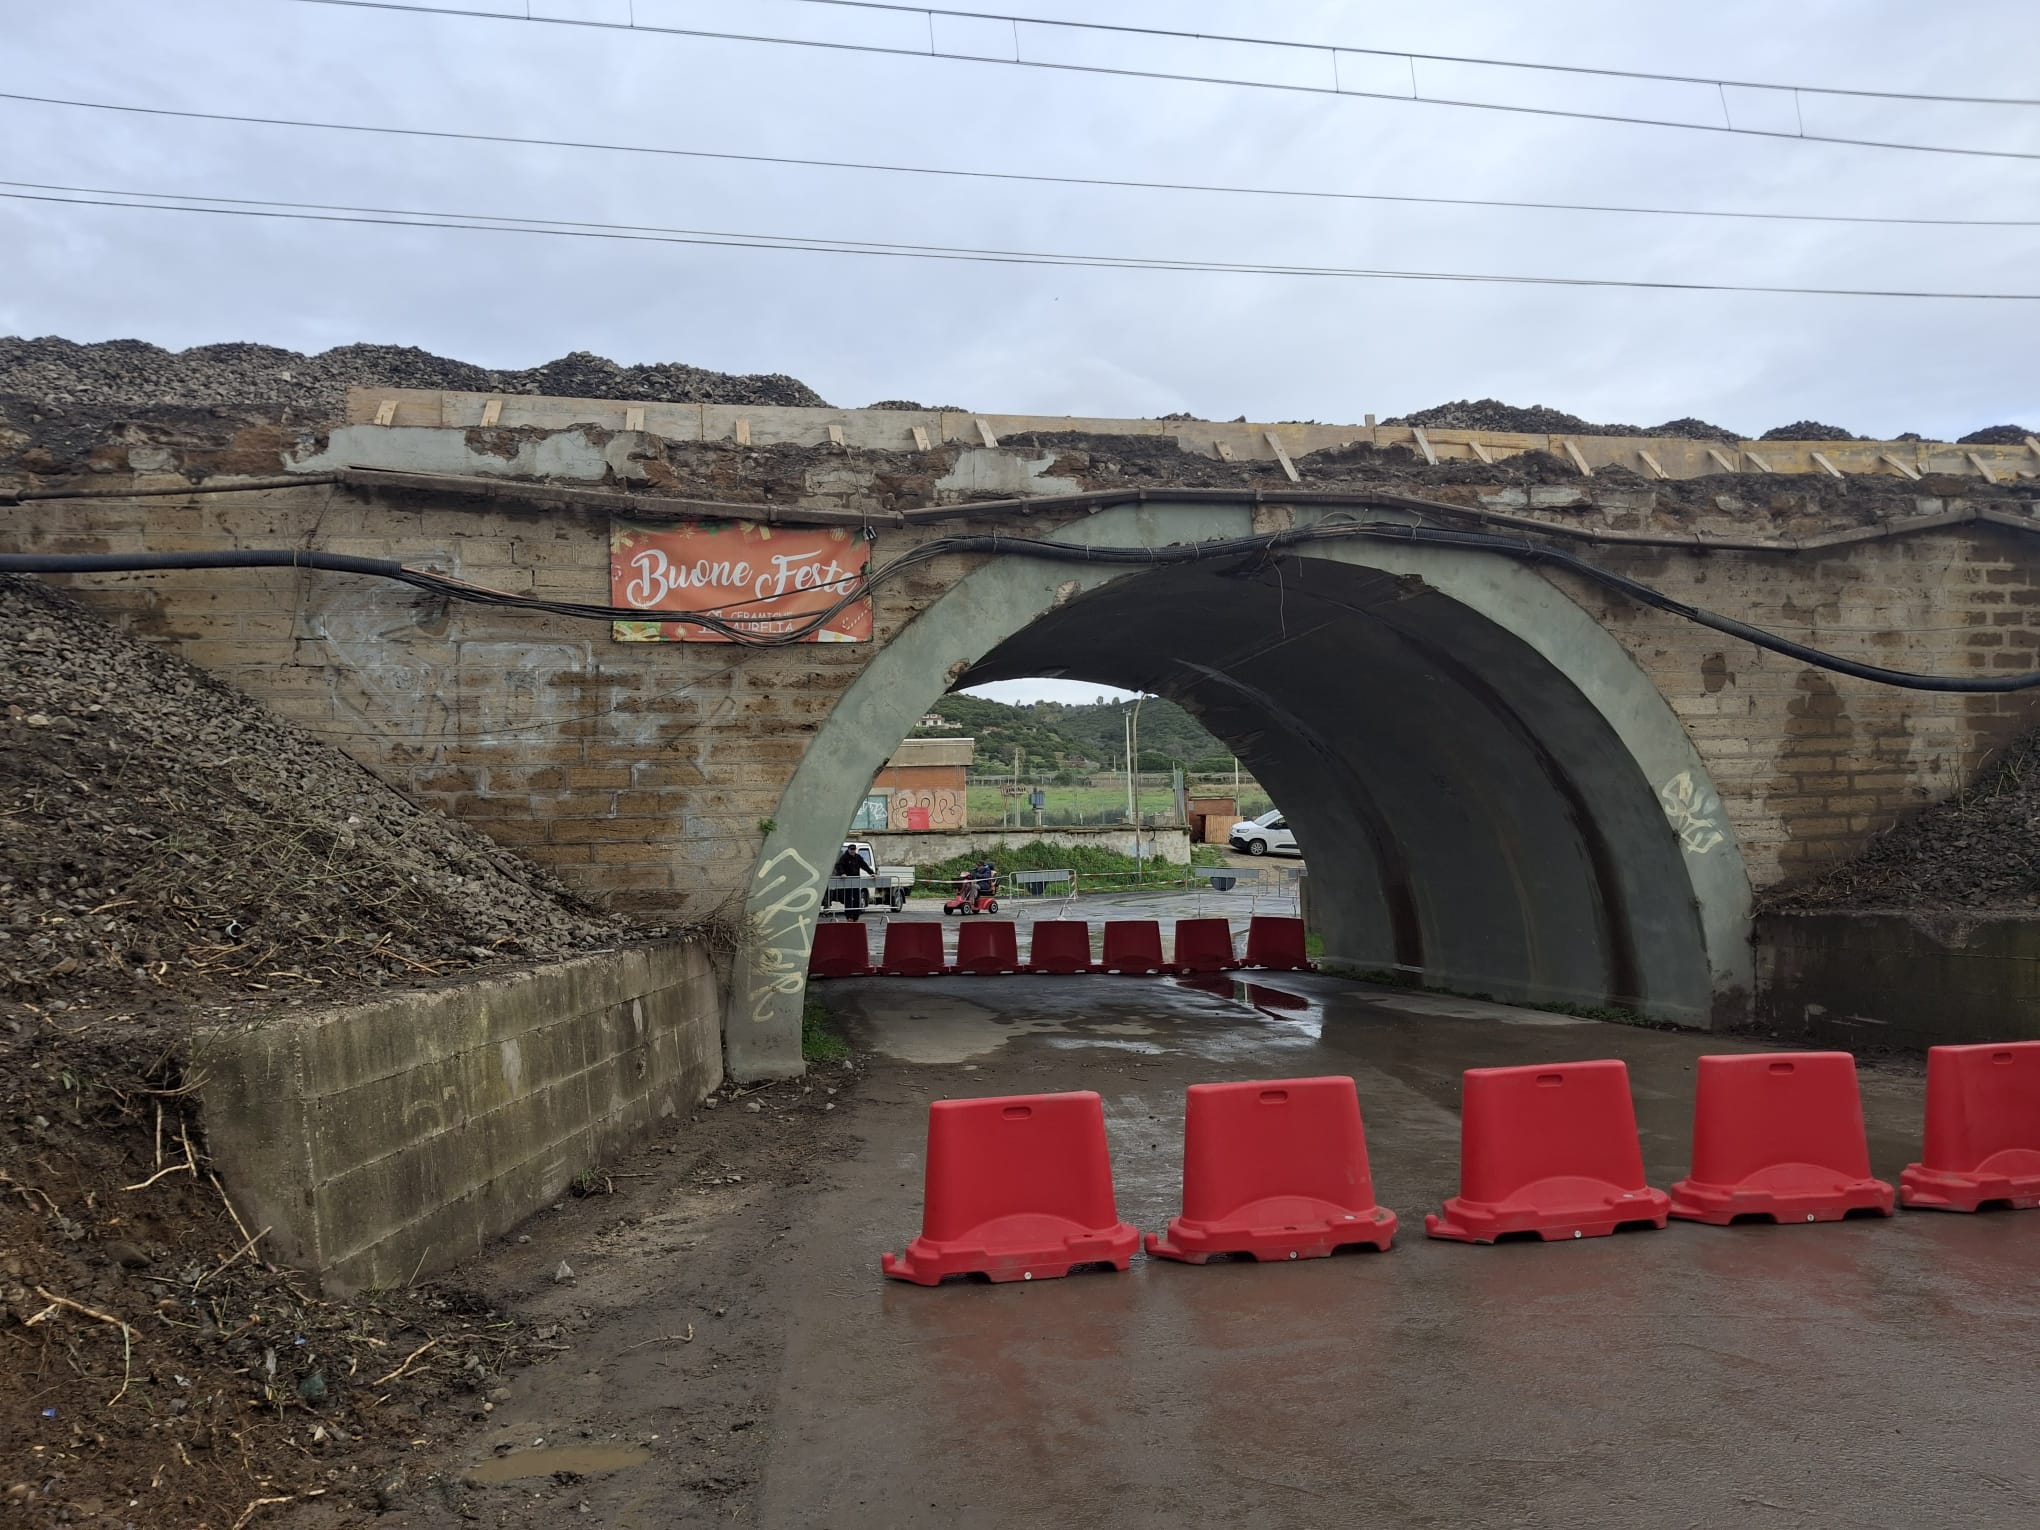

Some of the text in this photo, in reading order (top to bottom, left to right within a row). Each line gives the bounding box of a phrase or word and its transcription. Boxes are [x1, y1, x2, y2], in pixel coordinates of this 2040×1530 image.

[626, 549, 859, 607] Buone Feste
[733, 621, 794, 633] AURELIA
